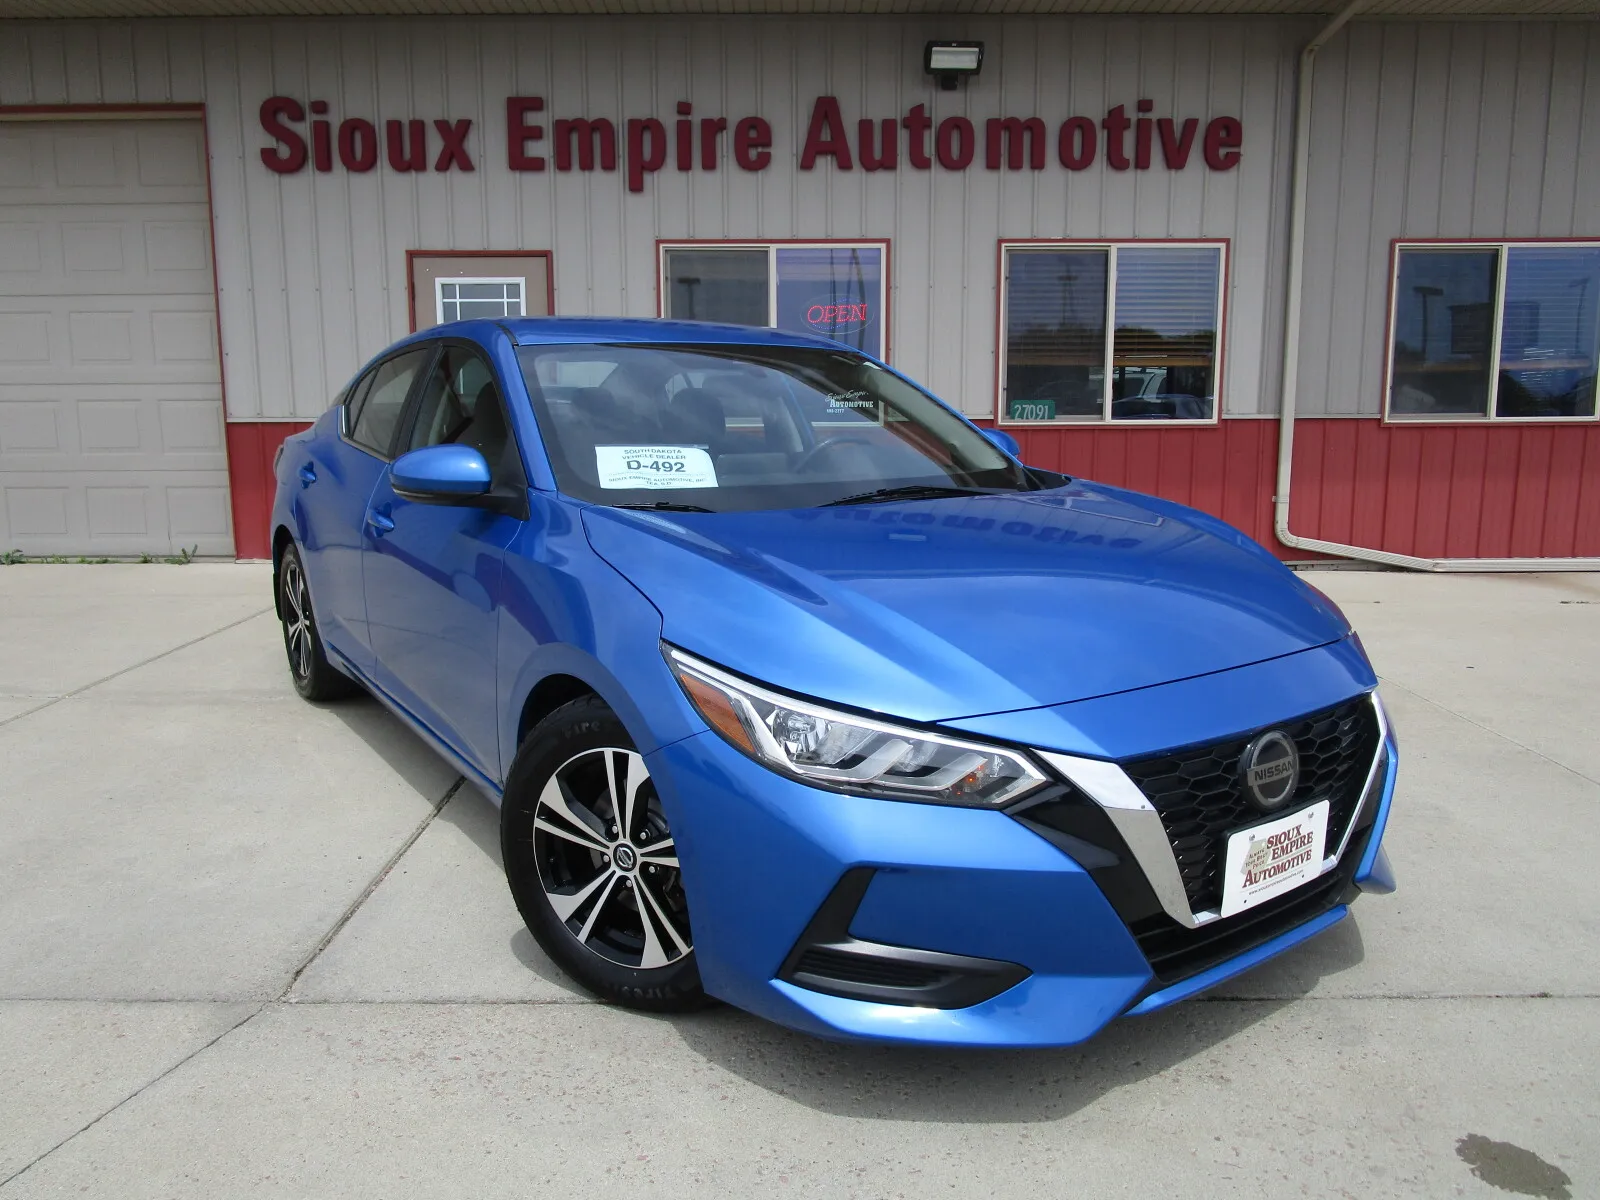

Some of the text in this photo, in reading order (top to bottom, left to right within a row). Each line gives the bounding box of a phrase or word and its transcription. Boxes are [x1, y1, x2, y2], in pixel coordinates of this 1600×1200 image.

[259, 95, 1243, 193] Sioux Empire Automotive
[807, 303, 868, 323] OPEN
[830, 399, 874, 408] AUTOMOTIVE
[1014, 404, 1049, 420] 27091
[626, 459, 687, 473] D-492
[1254, 760, 1294, 782] NISSAN
[1266, 823, 1303, 850] SIOUX
[1271, 831, 1314, 861] EMPIRE
[1242, 849, 1313, 889] AUTOMOTIVE
